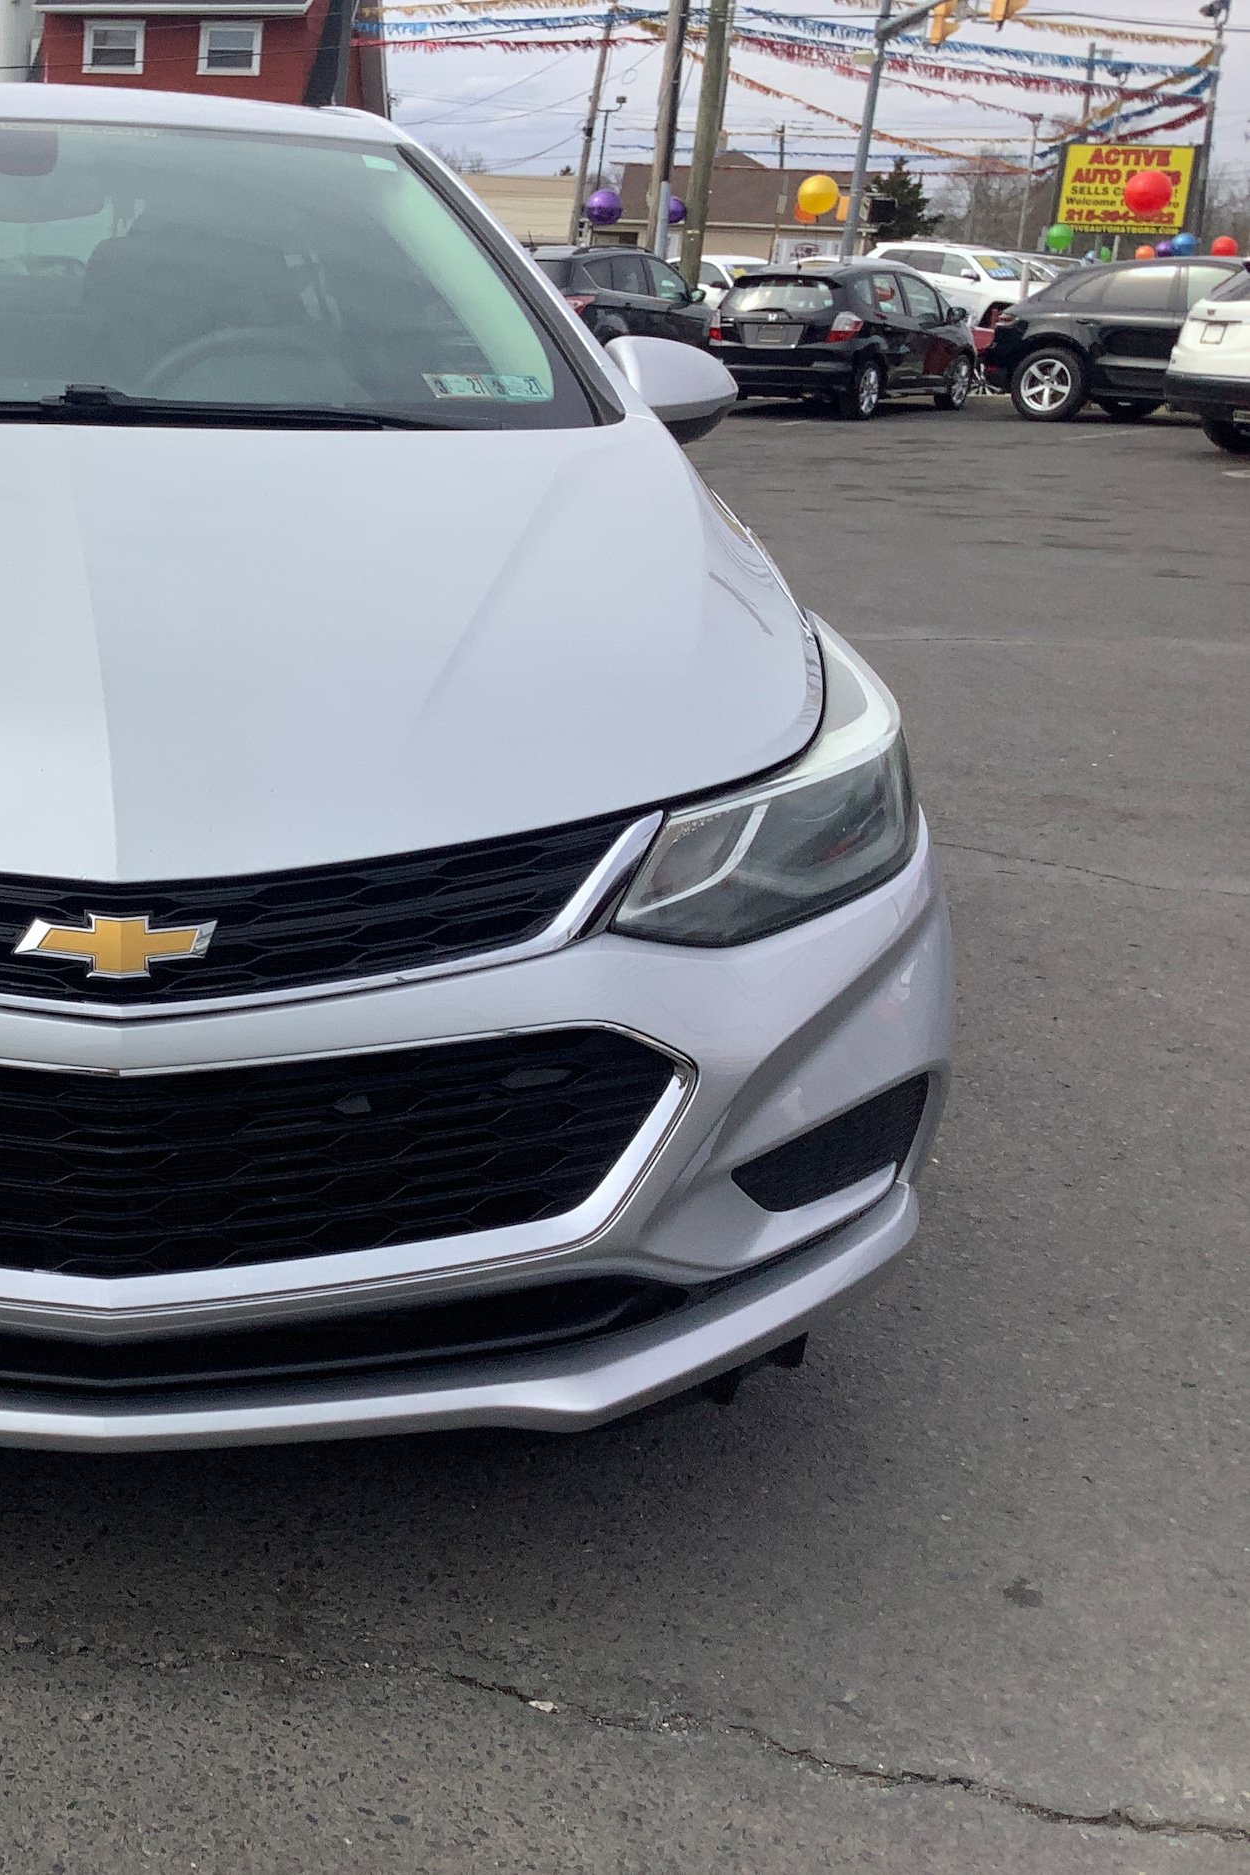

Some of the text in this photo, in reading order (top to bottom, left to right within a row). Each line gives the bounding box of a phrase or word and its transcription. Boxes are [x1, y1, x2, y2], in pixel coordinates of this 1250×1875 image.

[1088, 147, 1173, 167] ACTIVE
[1071, 167, 1122, 185] AUTO
[1071, 185, 1109, 196] SELLS
[1065, 196, 1117, 207] Welcome
